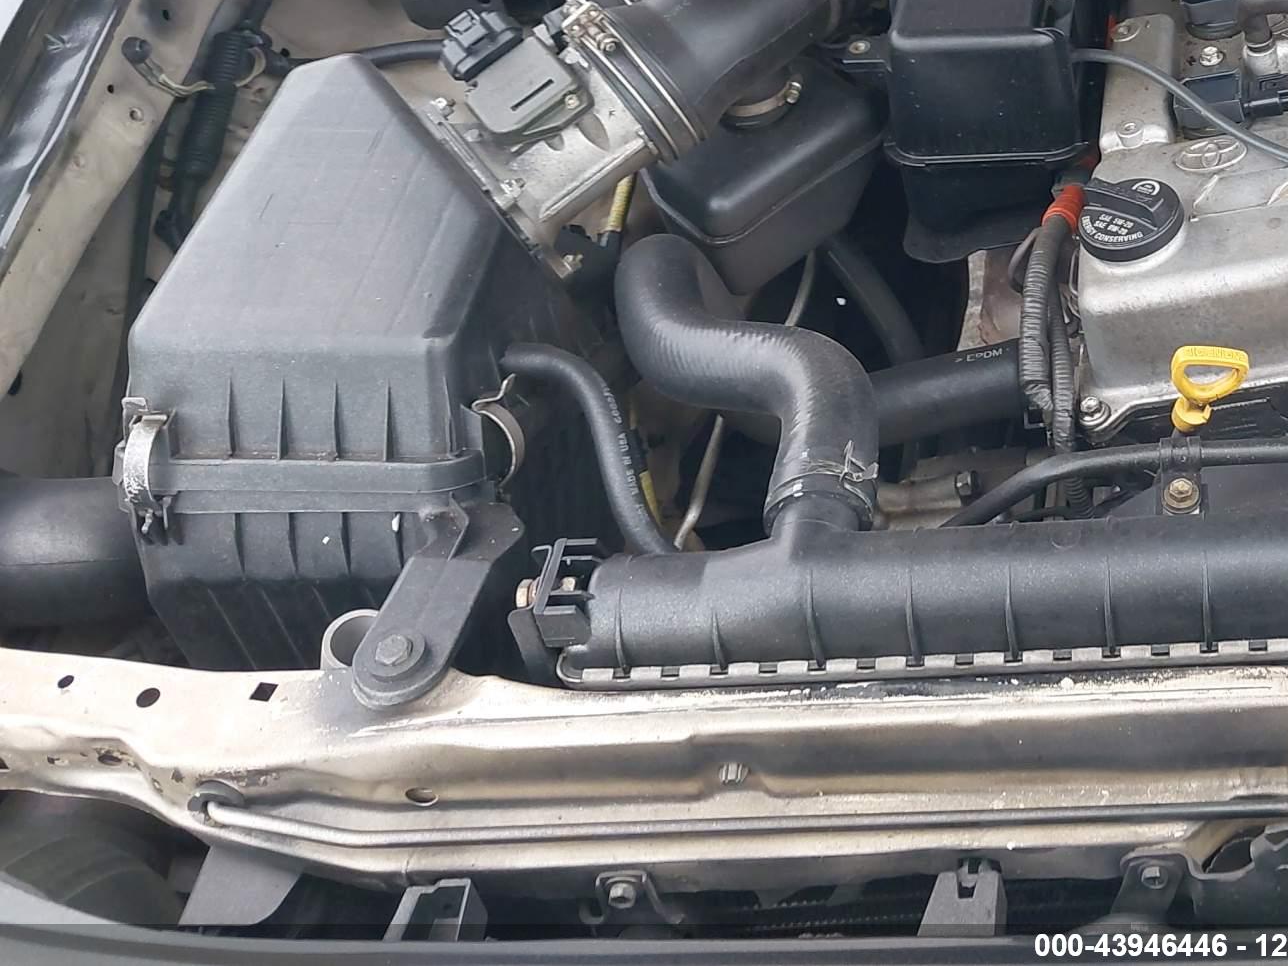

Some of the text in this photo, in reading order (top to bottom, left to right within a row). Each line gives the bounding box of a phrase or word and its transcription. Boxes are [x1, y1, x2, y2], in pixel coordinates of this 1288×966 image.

[1099, 213, 1112, 222] SAE
[1093, 220, 1107, 230] SAE
[1094, 231, 1144, 243] CONSERVING
[626, 469, 640, 495] MADE
